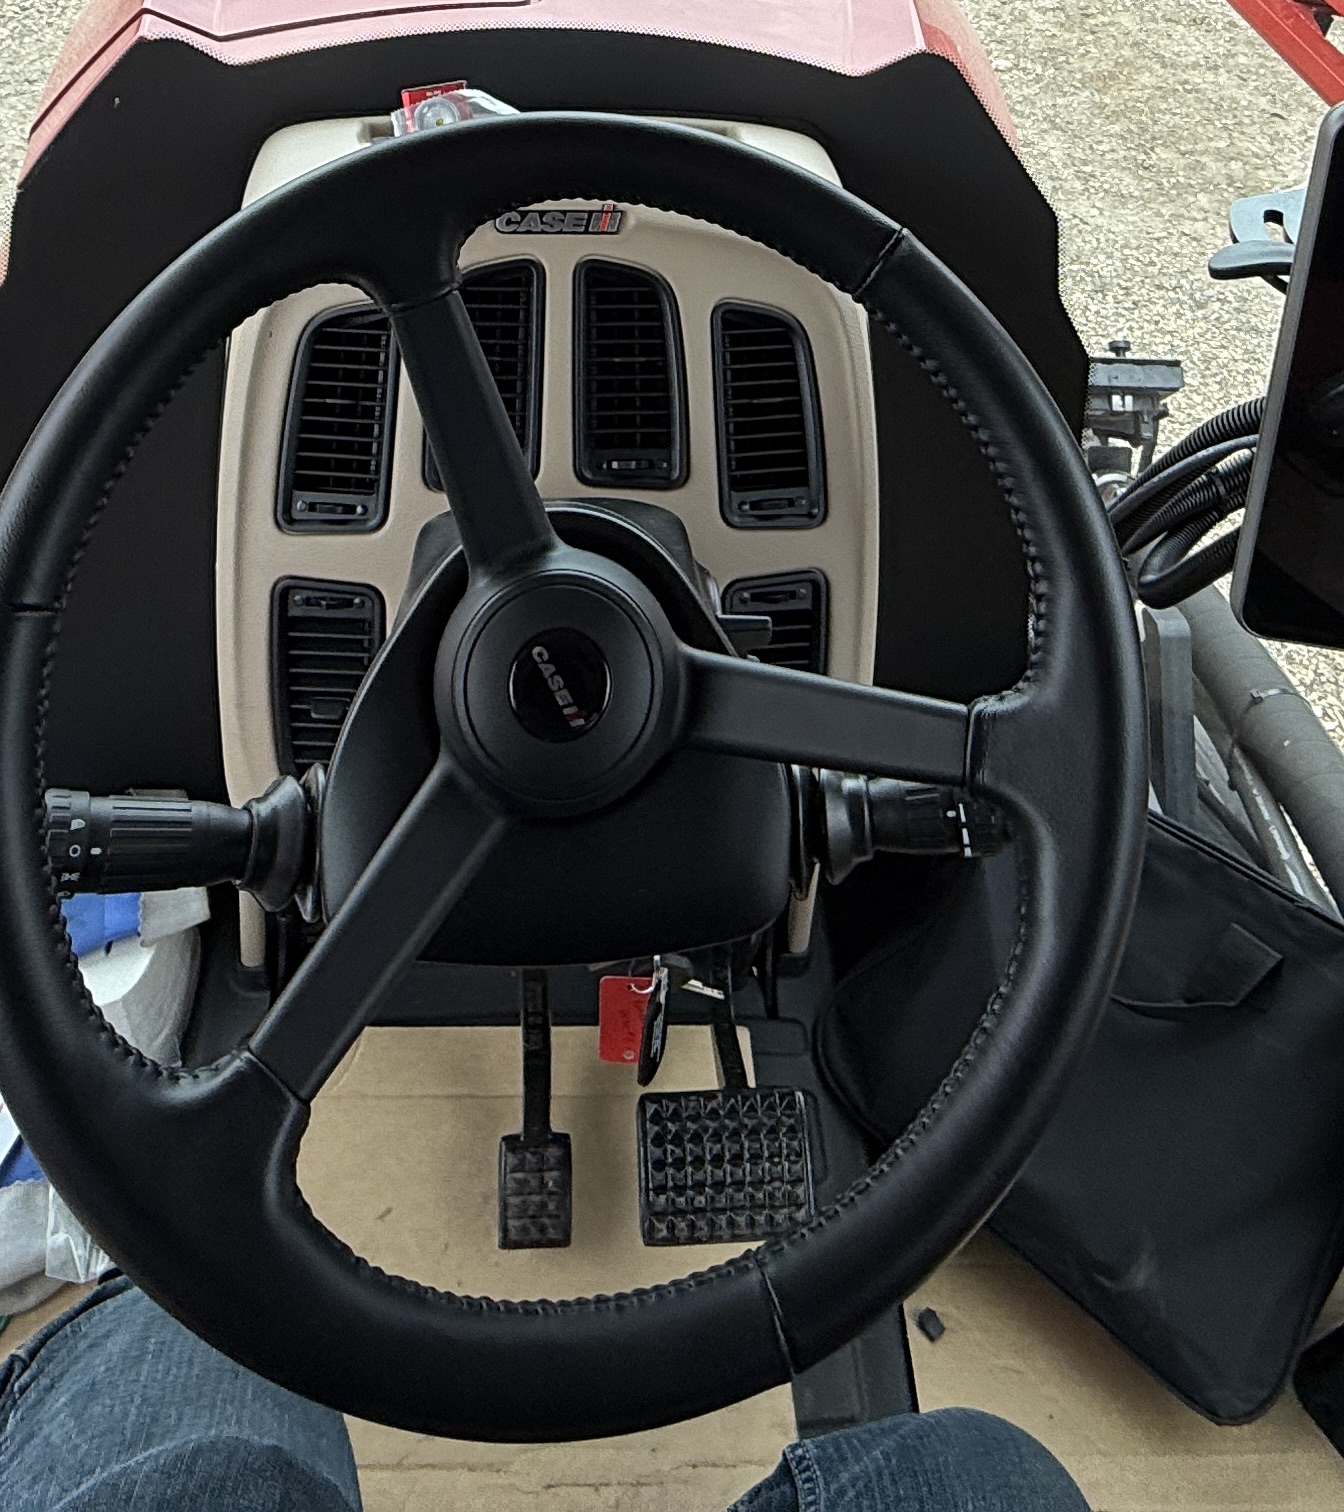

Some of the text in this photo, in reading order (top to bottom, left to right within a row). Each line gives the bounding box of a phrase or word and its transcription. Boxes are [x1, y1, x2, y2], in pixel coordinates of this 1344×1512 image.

[495, 203, 622, 233] CASE IH
[531, 646, 574, 707] CASE
